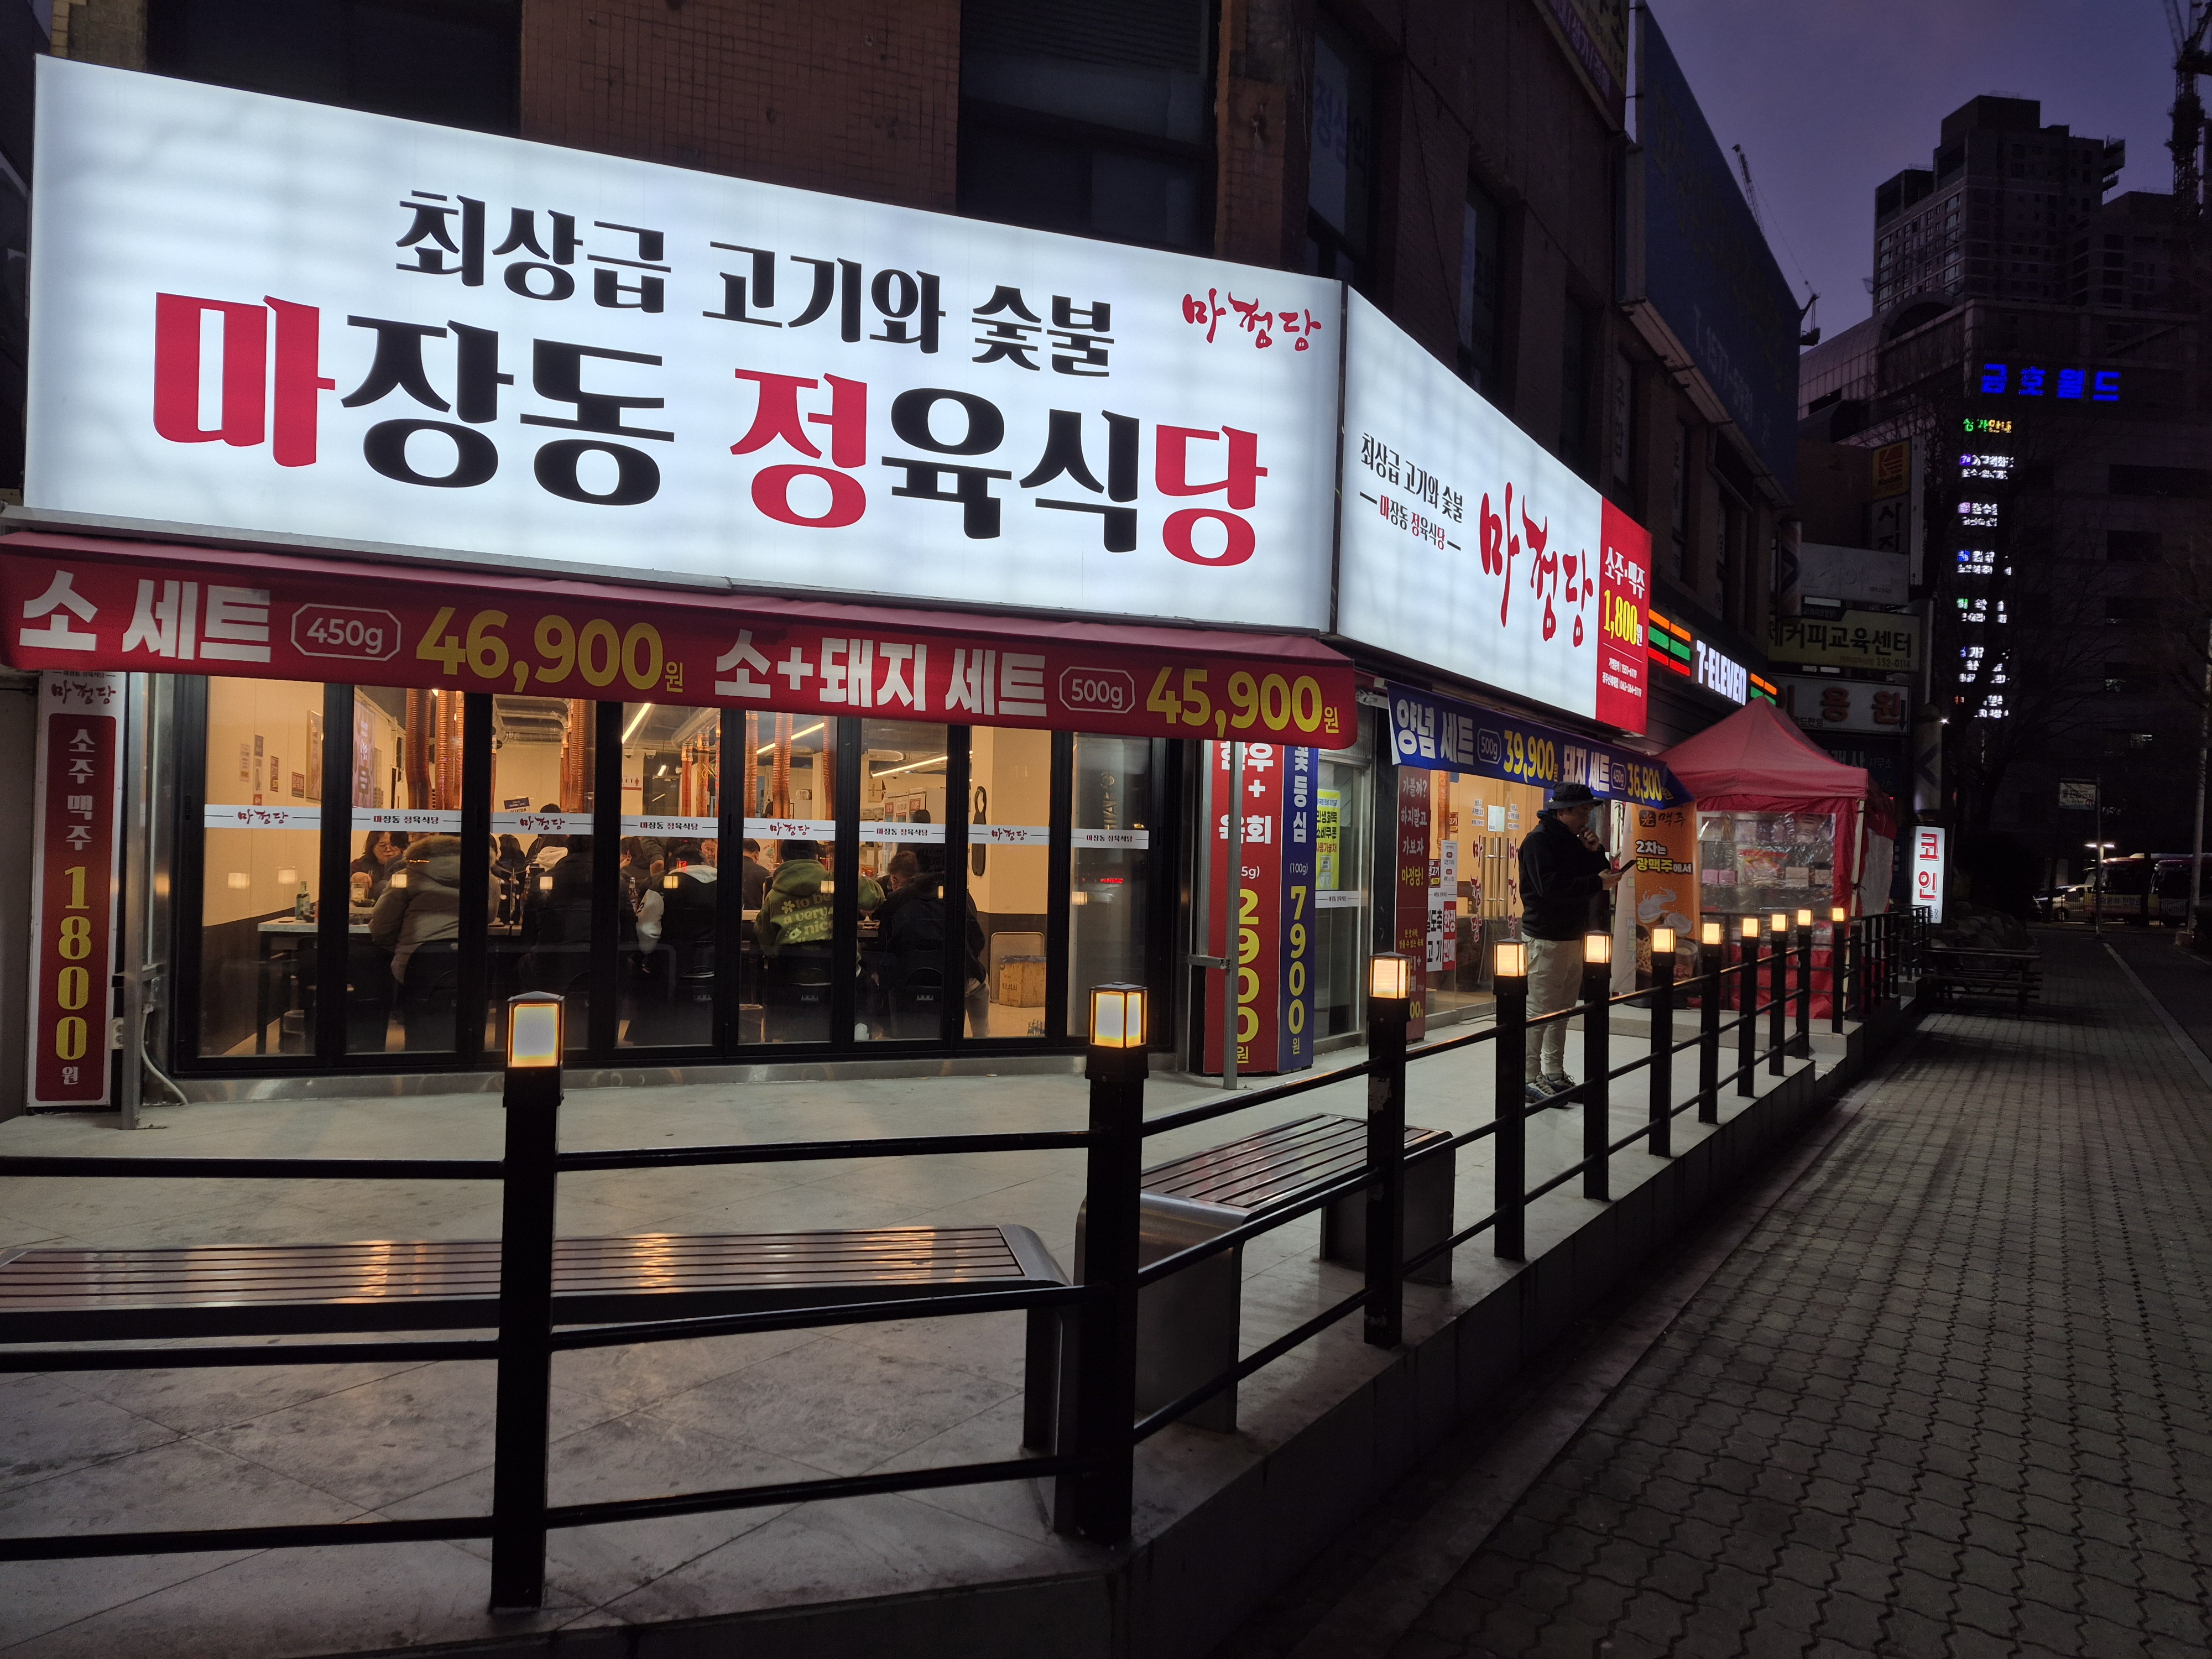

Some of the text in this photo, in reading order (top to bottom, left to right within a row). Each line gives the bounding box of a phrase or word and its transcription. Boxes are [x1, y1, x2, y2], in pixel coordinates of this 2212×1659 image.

[395, 190, 1115, 378] 최상급 고기와 숯불
[1981, 363, 2121, 401] 금호월드
[153, 291, 1269, 567] 마장동 정육식당
[1361, 432, 1463, 524] 최상급 고기와 숯불
[1380, 494, 1445, 550] 마장동 정육식당
[19, 570, 98, 652] 소
[122, 578, 272, 664] 세트
[306, 617, 384, 656] 450g
[714, 629, 928, 712] 소+돼지
[945, 648, 1048, 718] 세트
[1070, 677, 1125, 711] 500g
[67, 728, 96, 785] 소주
[1396, 698, 1436, 760] 양념
[1440, 711, 1474, 766] 세트
[1480, 735, 1498, 758] 500g
[1563, 744, 1587, 785] 돼지
[1588, 751, 1610, 792] 세트
[1613, 769, 1625, 786] 450g
[1402, 776, 1427, 799] 가볼까?
[65, 794, 93, 852] 맥주
[373, 814, 440, 825] 마장동 정육식당
[667, 822, 698, 831] 정육식당
[1400, 806, 1427, 827] 하지말고
[1086, 834, 1134, 843] 마장동 정육식당
[1402, 837, 1425, 857] 가보자
[1636, 840, 1667, 855] 2차는
[1240, 865, 1260, 880] 5g)
[1290, 862, 1308, 876] (100g)
[1401, 867, 1423, 887] 마정당!
[1636, 857, 1692, 874] 광맥주에서
[1918, 833, 1940, 901] 코인
[795, 893, 832, 909] to be
[783, 907, 828, 924] a very
[1427, 909, 1456, 933] 일도축 한정
[1443, 938, 1455, 963] 판매
